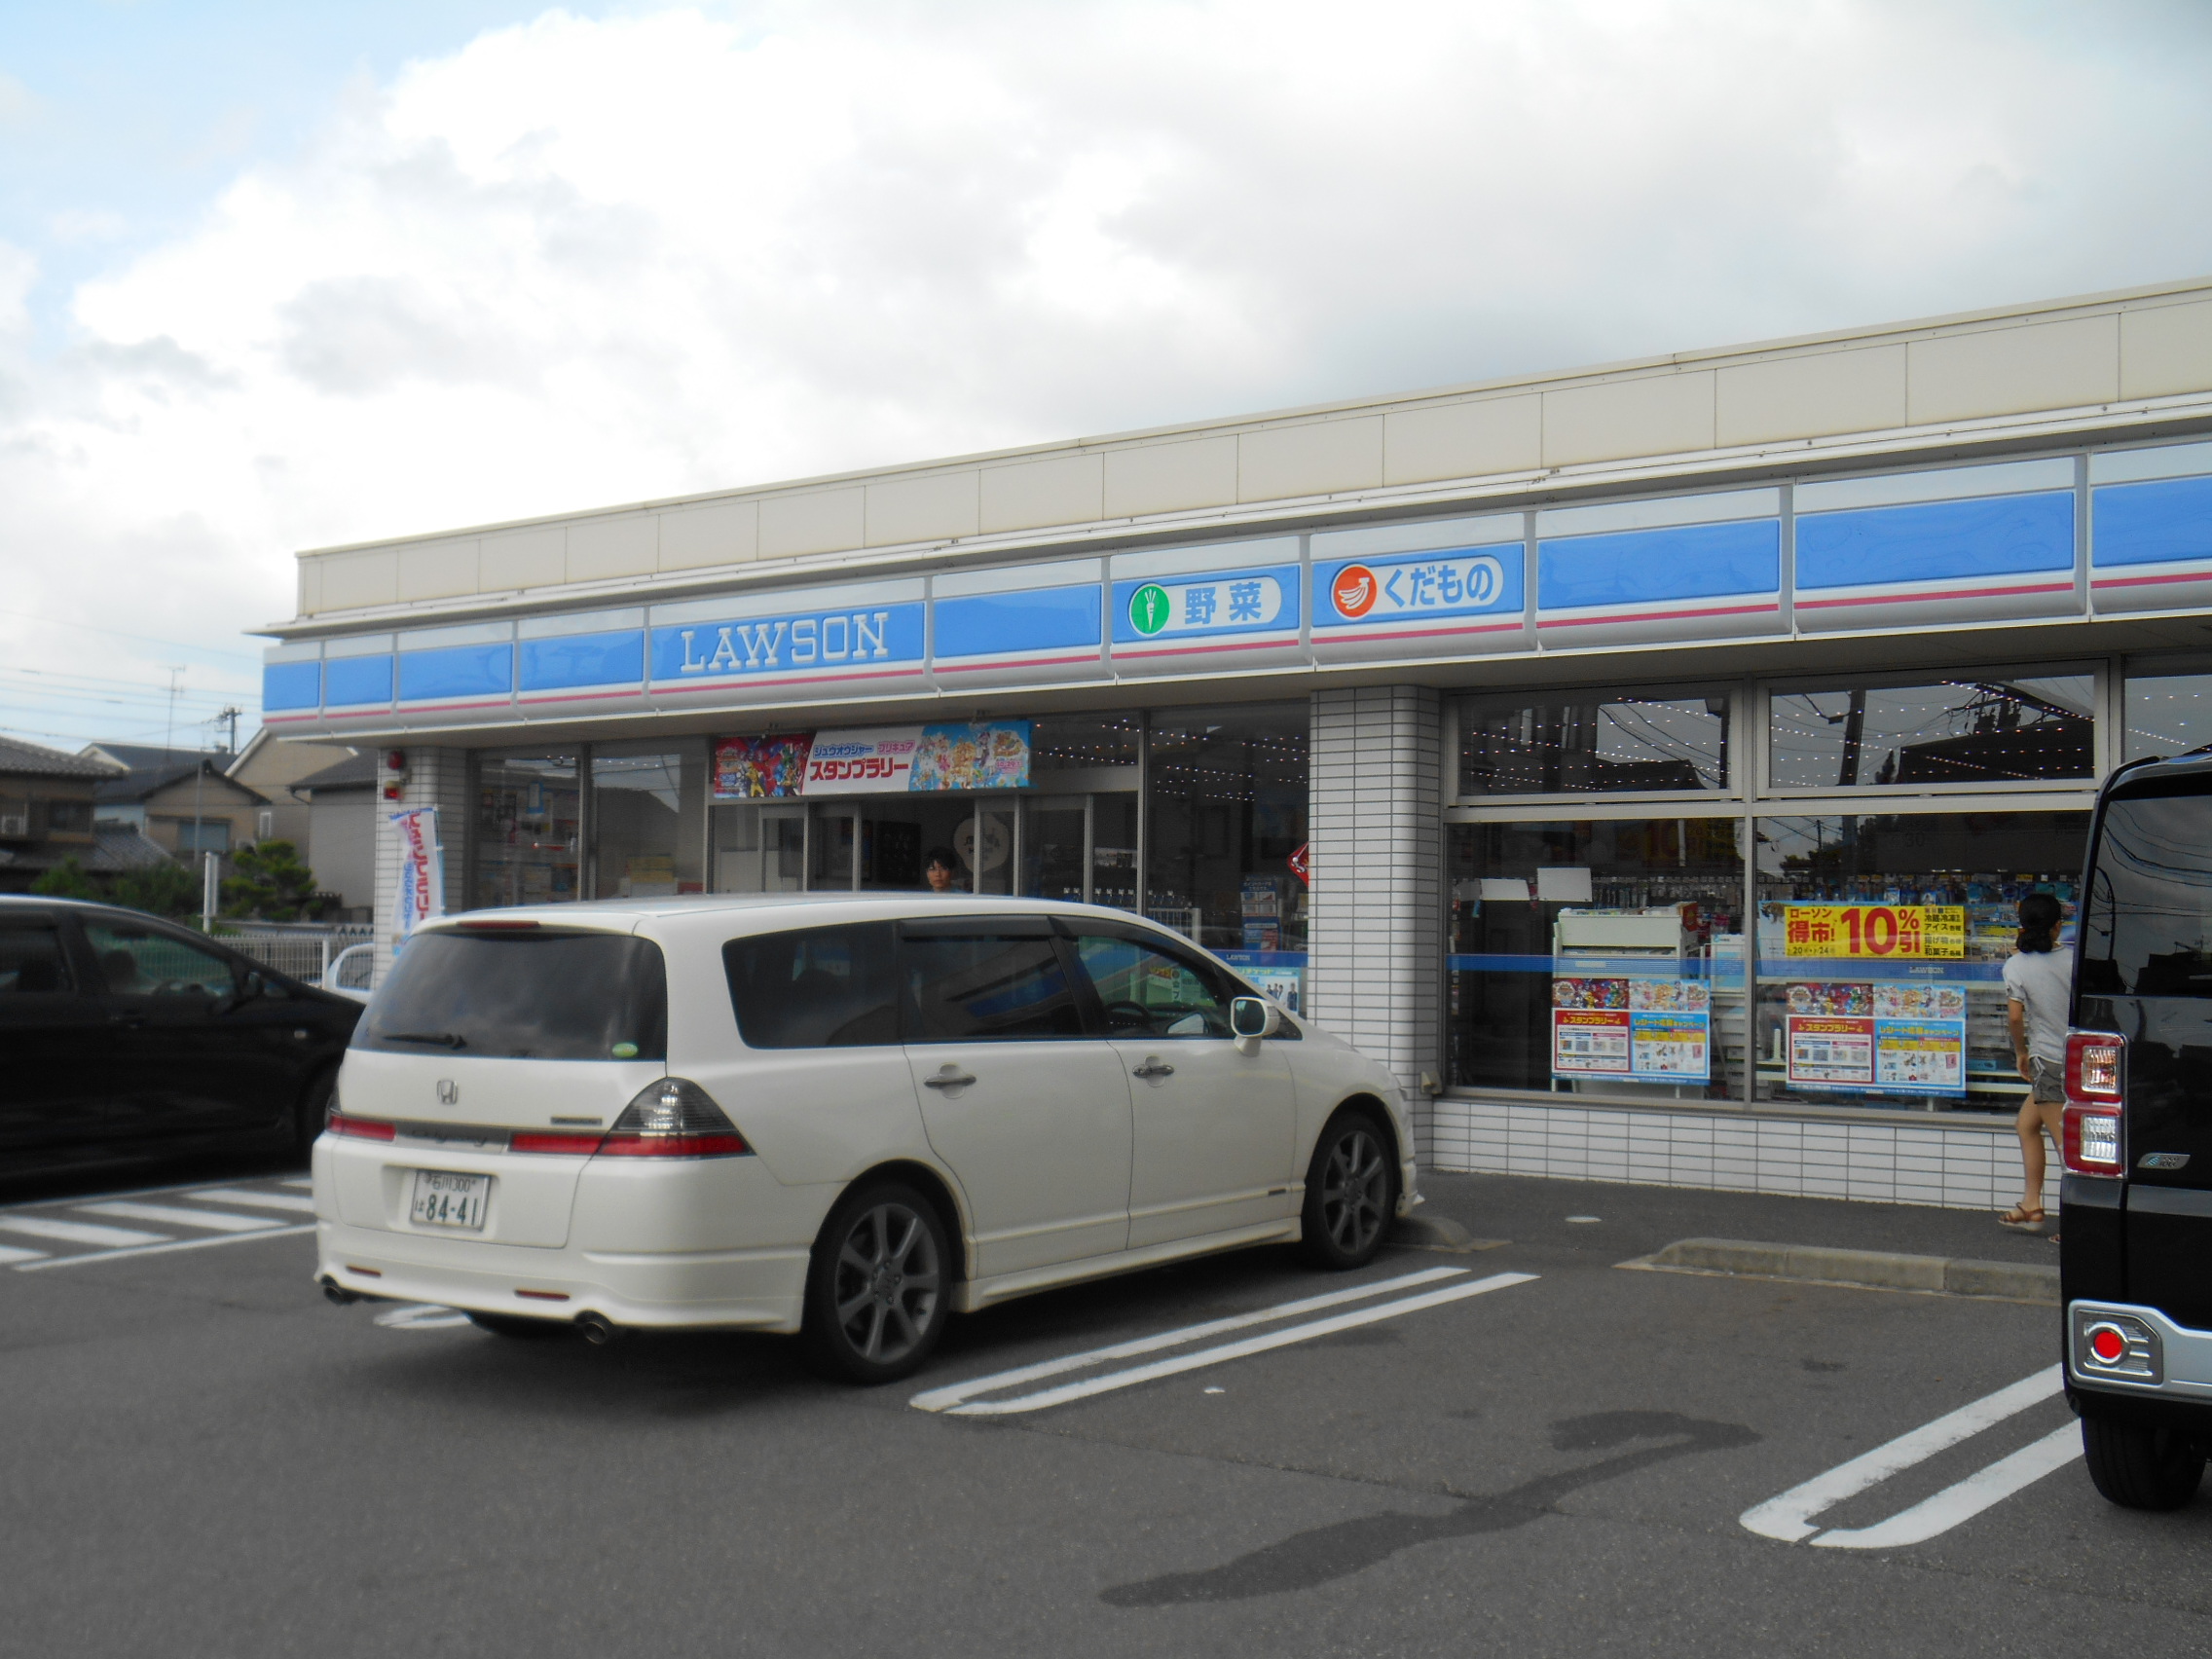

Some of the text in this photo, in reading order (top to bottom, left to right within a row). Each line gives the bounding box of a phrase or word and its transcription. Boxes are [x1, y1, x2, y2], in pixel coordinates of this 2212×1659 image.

[1184, 582, 1263, 625] 野菜
[1384, 564, 1494, 608] くだもの
[681, 611, 889, 673] LAWSON
[810, 757, 909, 781] スタンプラリー
[1789, 908, 1832, 919] ローソン
